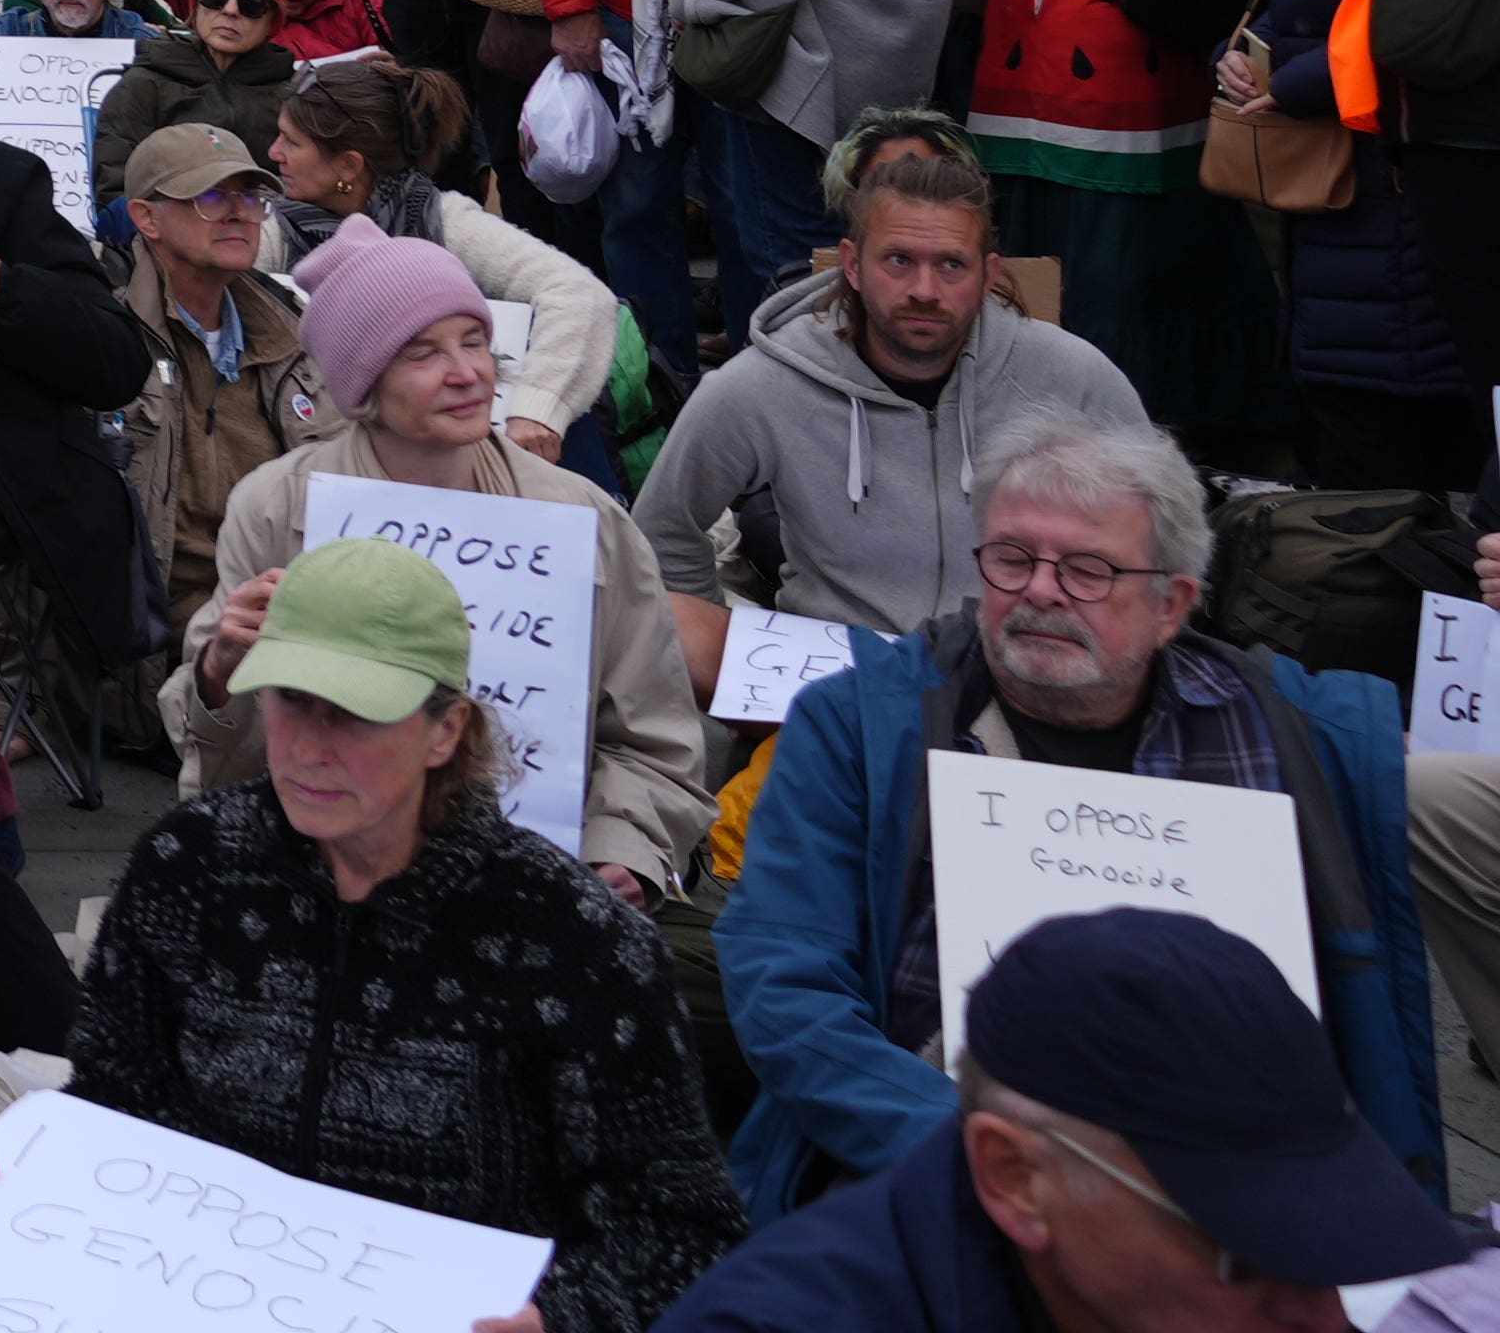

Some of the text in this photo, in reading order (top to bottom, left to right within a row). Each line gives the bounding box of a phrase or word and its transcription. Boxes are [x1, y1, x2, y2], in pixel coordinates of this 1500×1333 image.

[376, 518, 553, 577] OPPOSE
[977, 791, 1191, 845] I OPPOSE
[1030, 847, 1194, 897] Genocide
[13, 1124, 416, 1295] I OPPOSE
